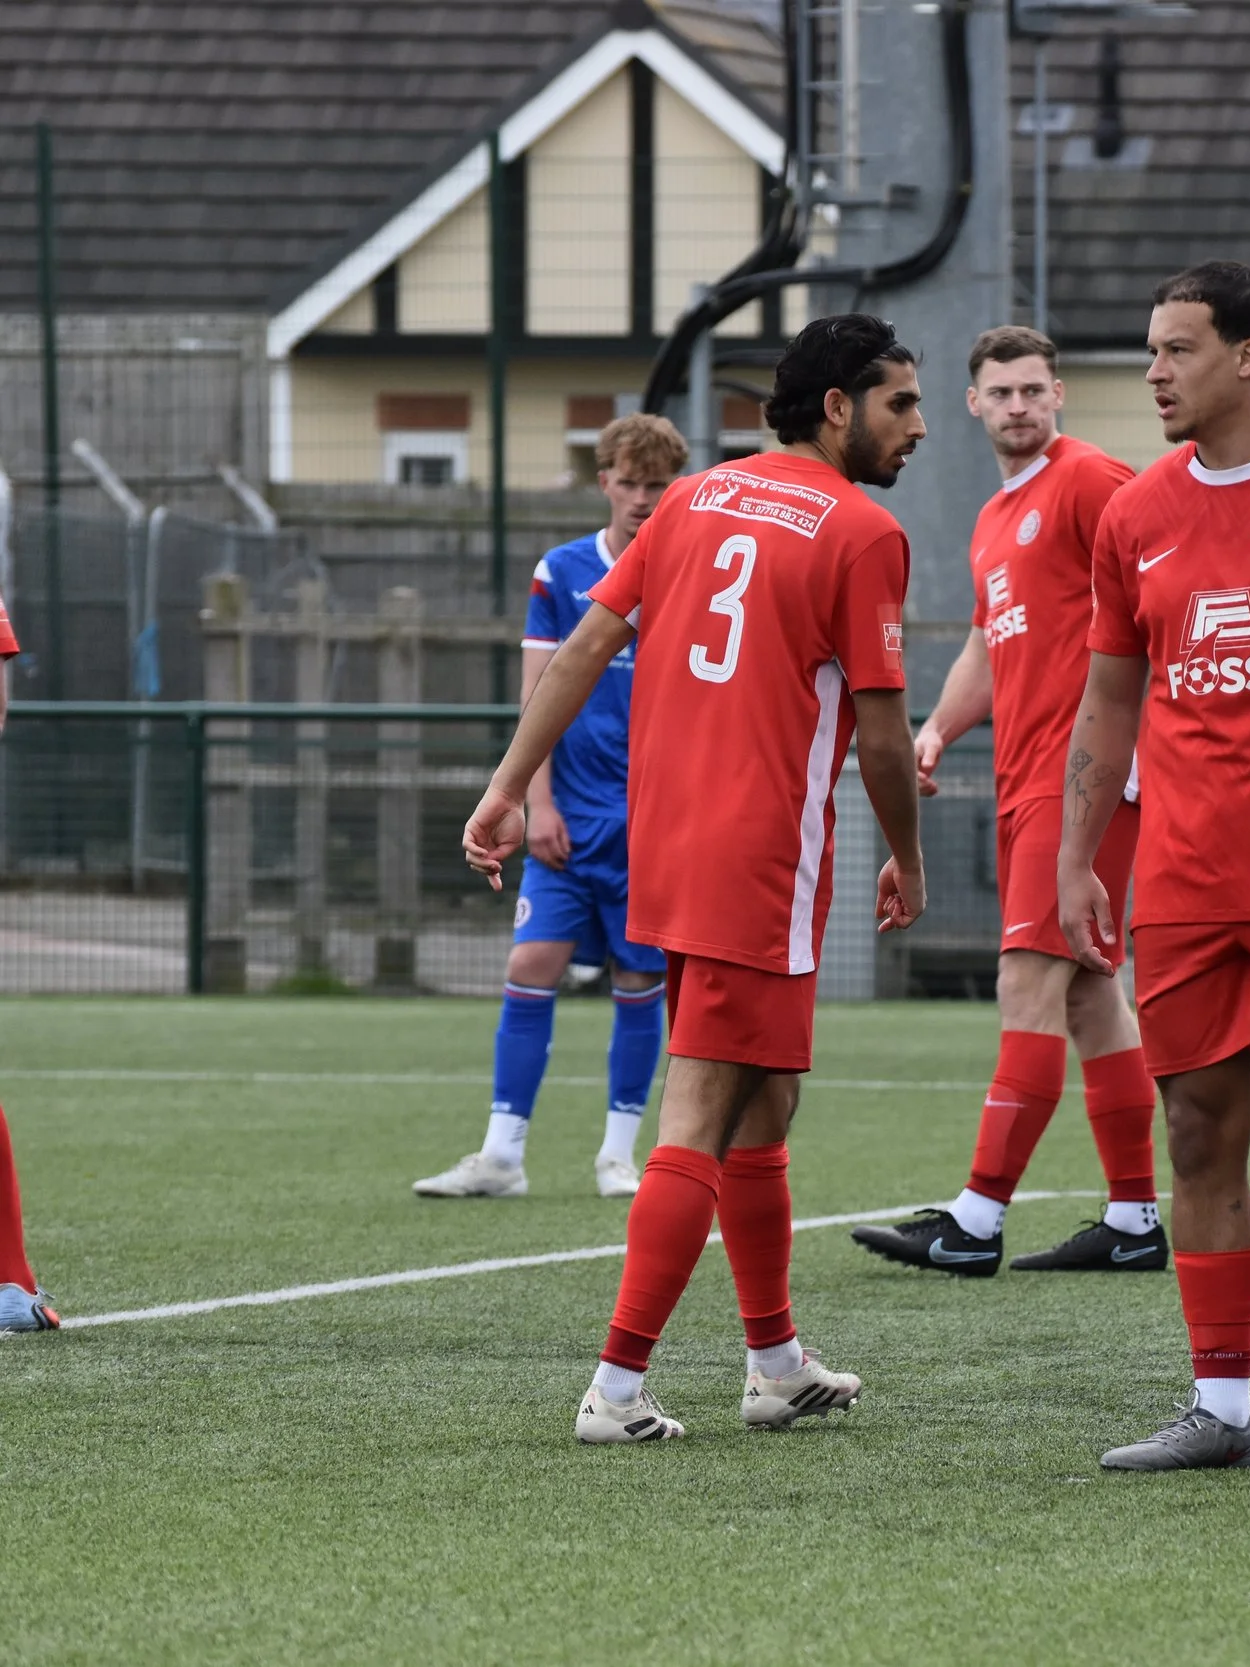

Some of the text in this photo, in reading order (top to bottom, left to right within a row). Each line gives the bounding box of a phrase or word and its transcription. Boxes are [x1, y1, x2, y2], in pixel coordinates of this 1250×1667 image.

[709, 471, 829, 507] Stag Fencing & Groundworks
[739, 501, 815, 530] TEL: 07718 882 424
[689, 534, 757, 684] 3
